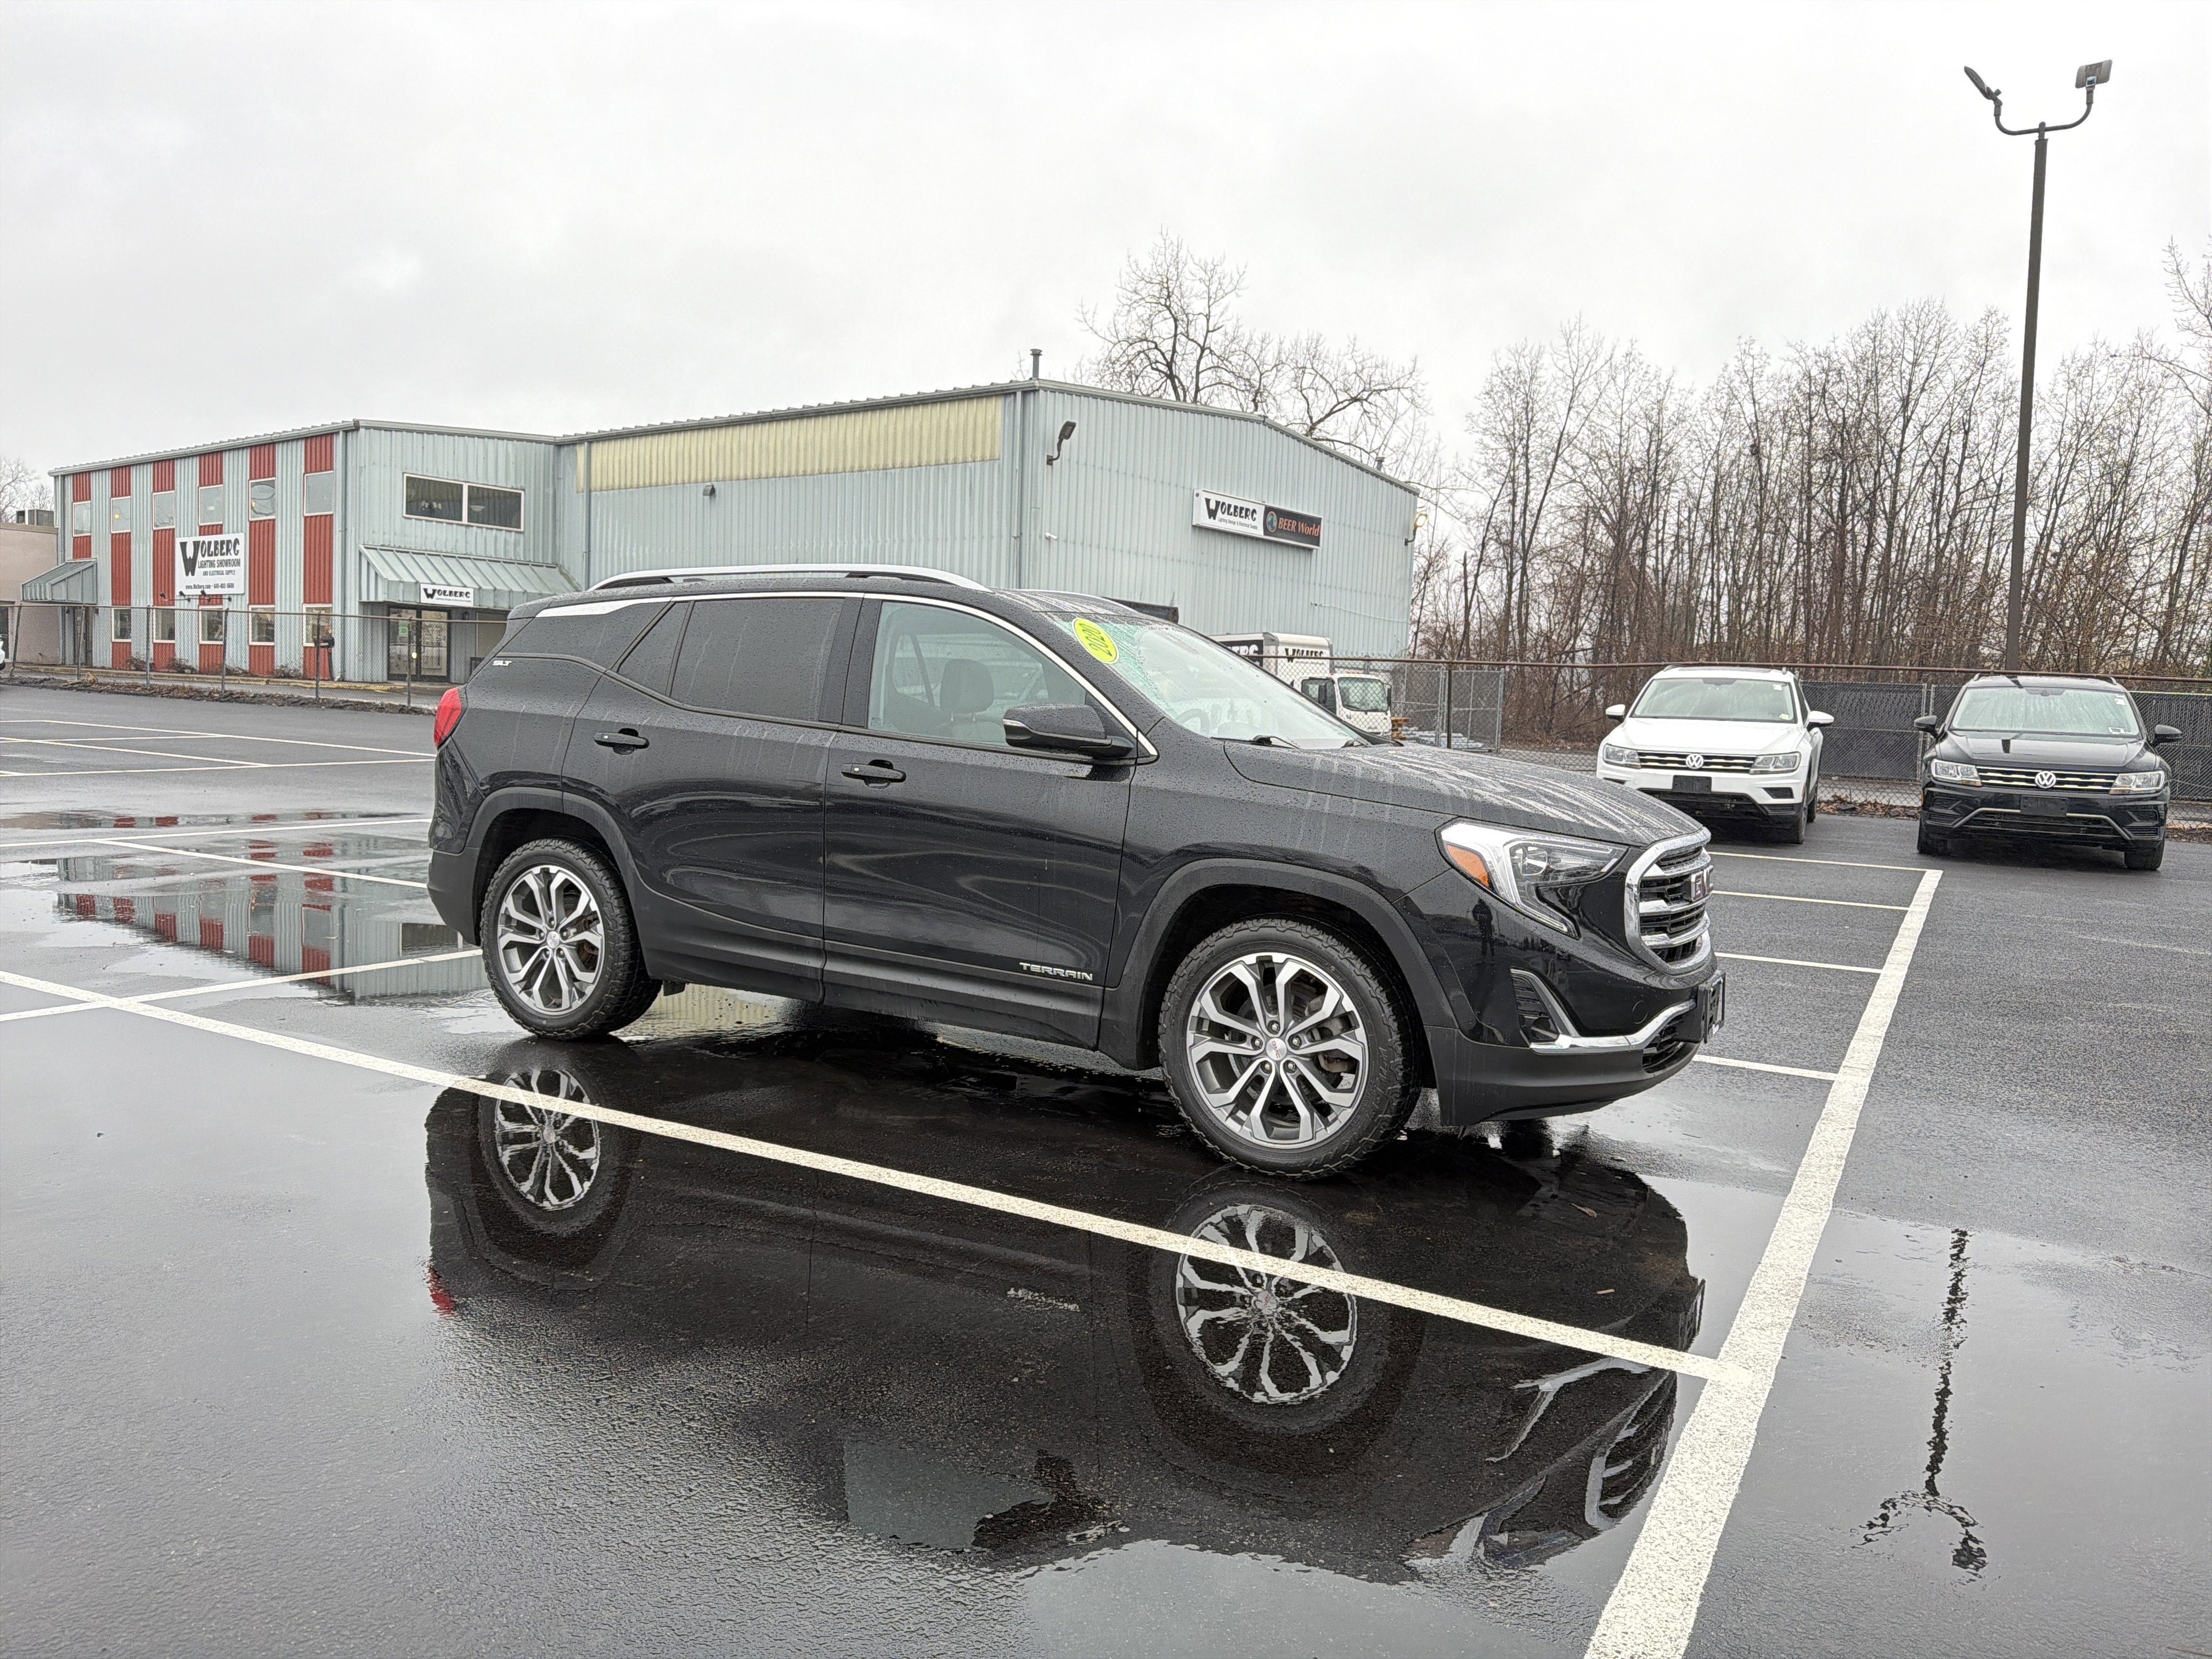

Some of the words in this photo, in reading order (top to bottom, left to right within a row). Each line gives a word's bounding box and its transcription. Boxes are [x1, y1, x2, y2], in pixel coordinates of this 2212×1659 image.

[1205, 498, 1257, 521] WOLBERG
[1278, 517, 1296, 532] BEER
[1298, 521, 1320, 536] World
[179, 538, 240, 577] WOLBERG
[198, 559, 216, 568] LIGHTING
[217, 558, 241, 568] SHOWROOM
[423, 588, 471, 600] WOLBERG
[1079, 623, 1113, 657] 2020
[1019, 962, 1093, 981] TERRAIN
[1272, 1040, 1281, 1059] GMC
